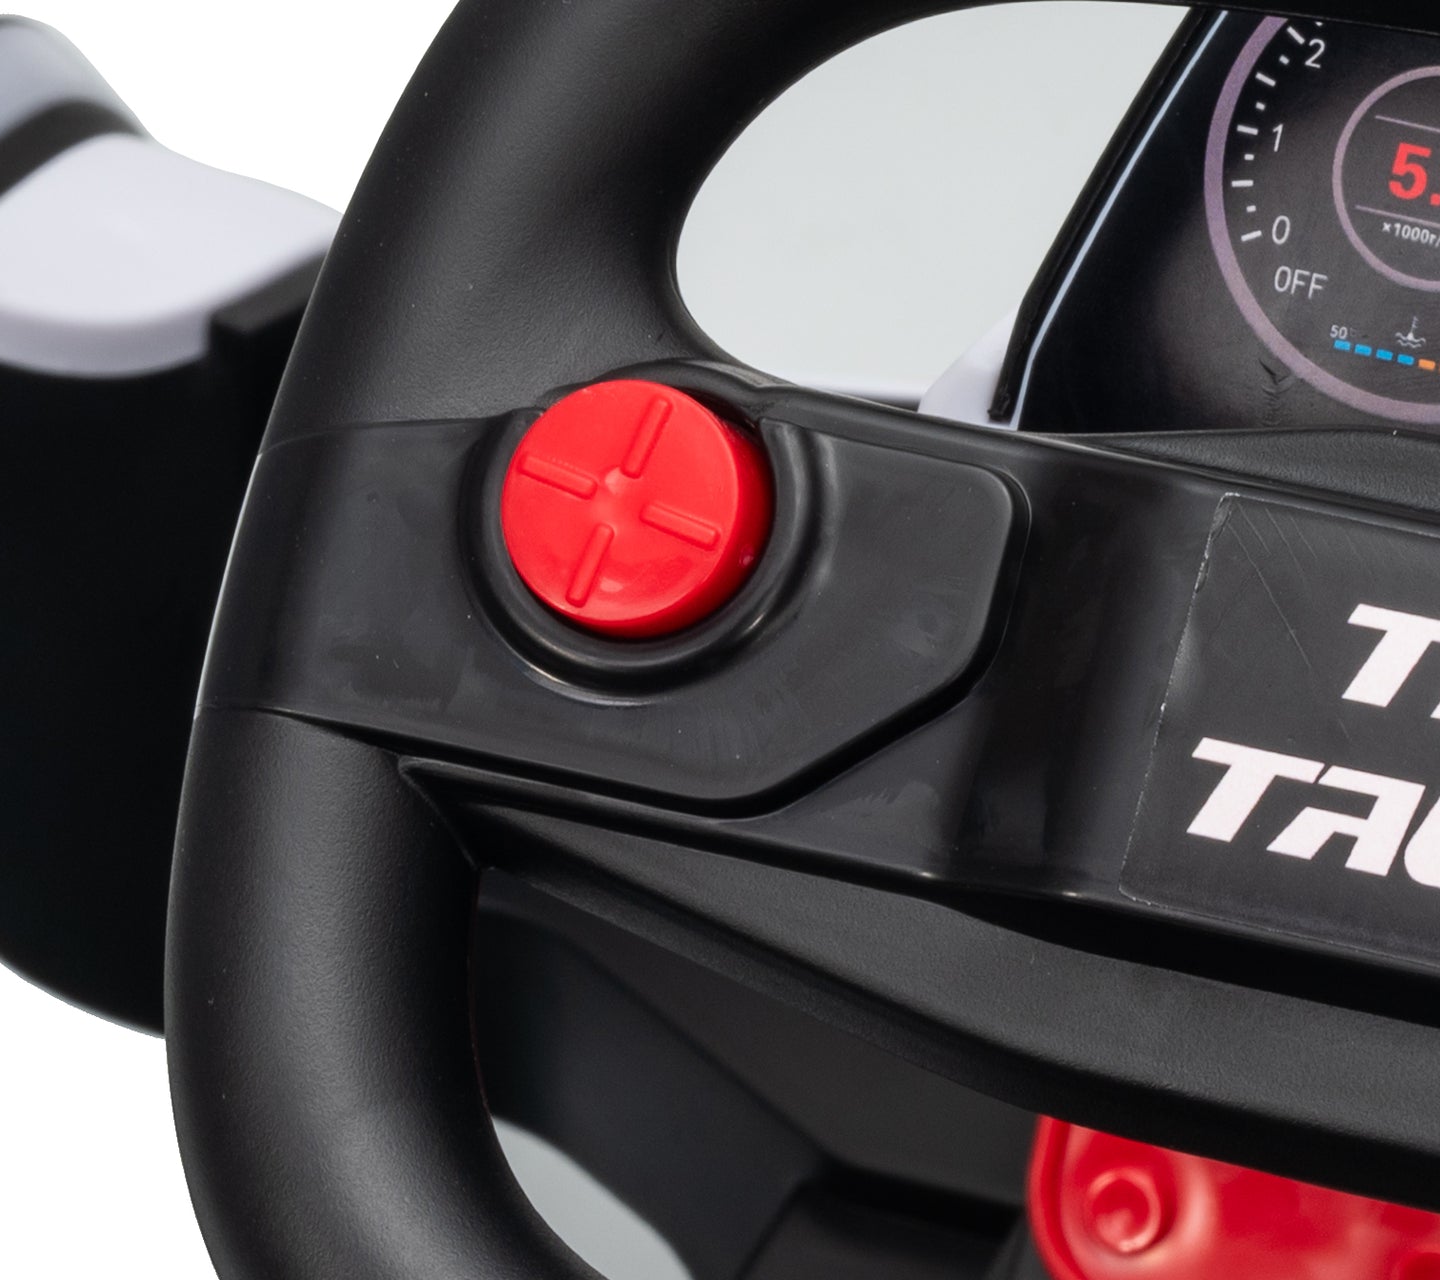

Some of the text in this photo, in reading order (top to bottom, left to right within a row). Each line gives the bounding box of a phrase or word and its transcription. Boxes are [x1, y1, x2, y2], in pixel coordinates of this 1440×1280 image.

[1305, 38, 1326, 69] 2
[1271, 124, 1284, 153] 1
[1271, 216, 1291, 245] 0
[1274, 266, 1328, 300] OFF
